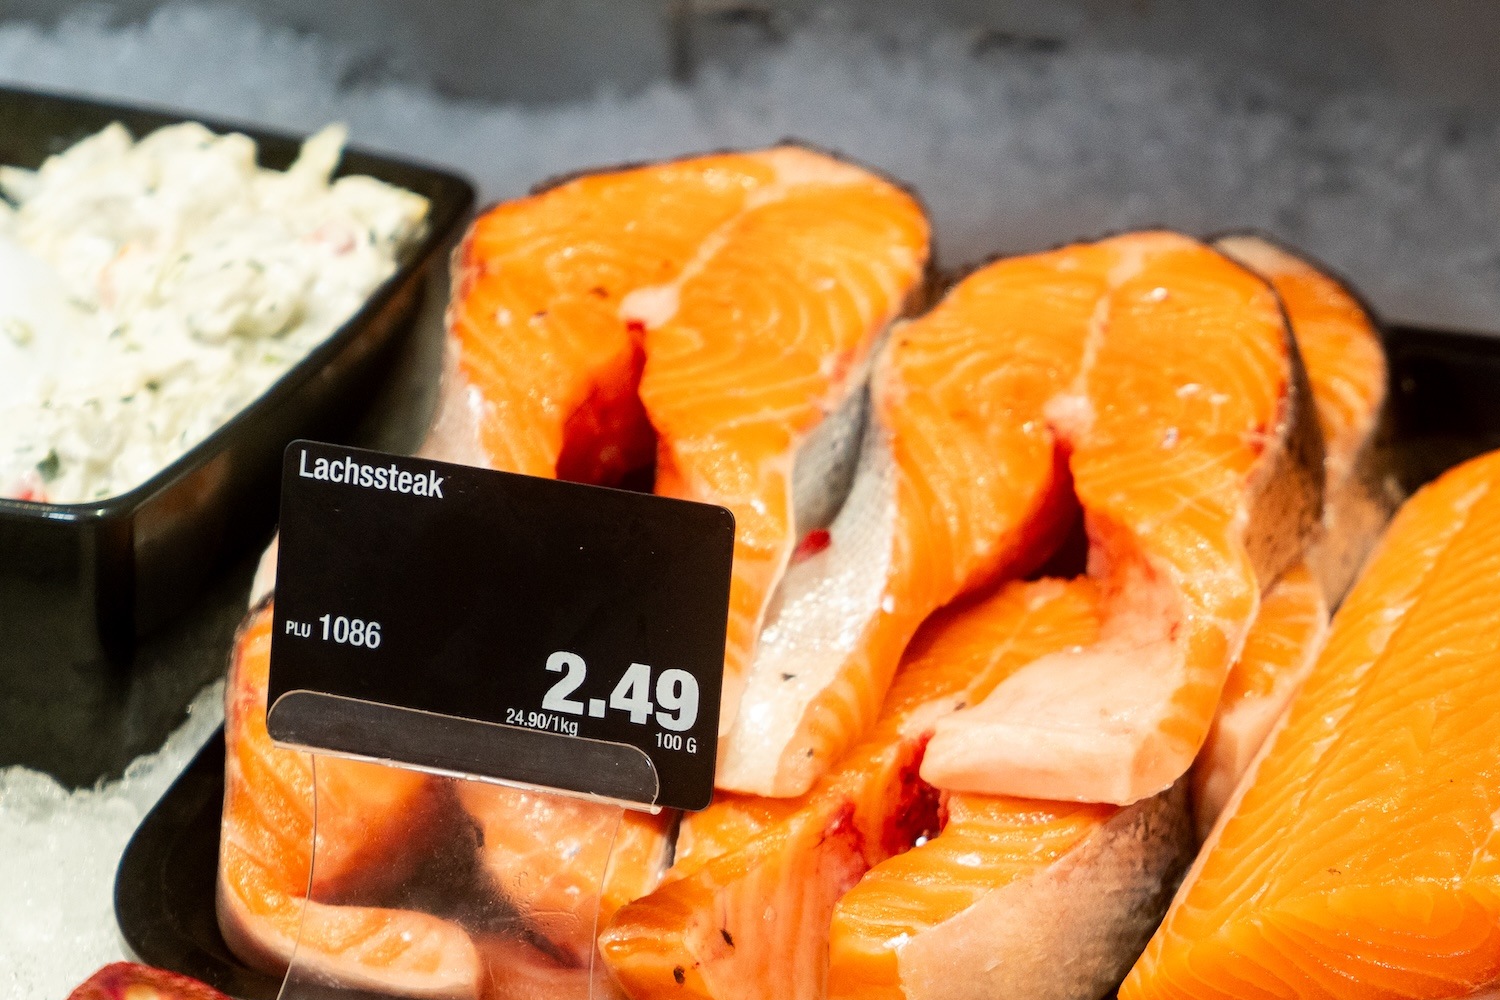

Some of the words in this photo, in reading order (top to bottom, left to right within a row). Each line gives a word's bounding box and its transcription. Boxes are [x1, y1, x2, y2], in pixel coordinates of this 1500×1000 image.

[300, 449, 444, 499] Lachssteak
[285, 619, 312, 639] PLU
[318, 613, 382, 649] 1086
[541, 650, 700, 732] 2.49
[505, 708, 579, 737] 24.90/1kg
[655, 732, 682, 751] 100
[686, 737, 697, 754] G
